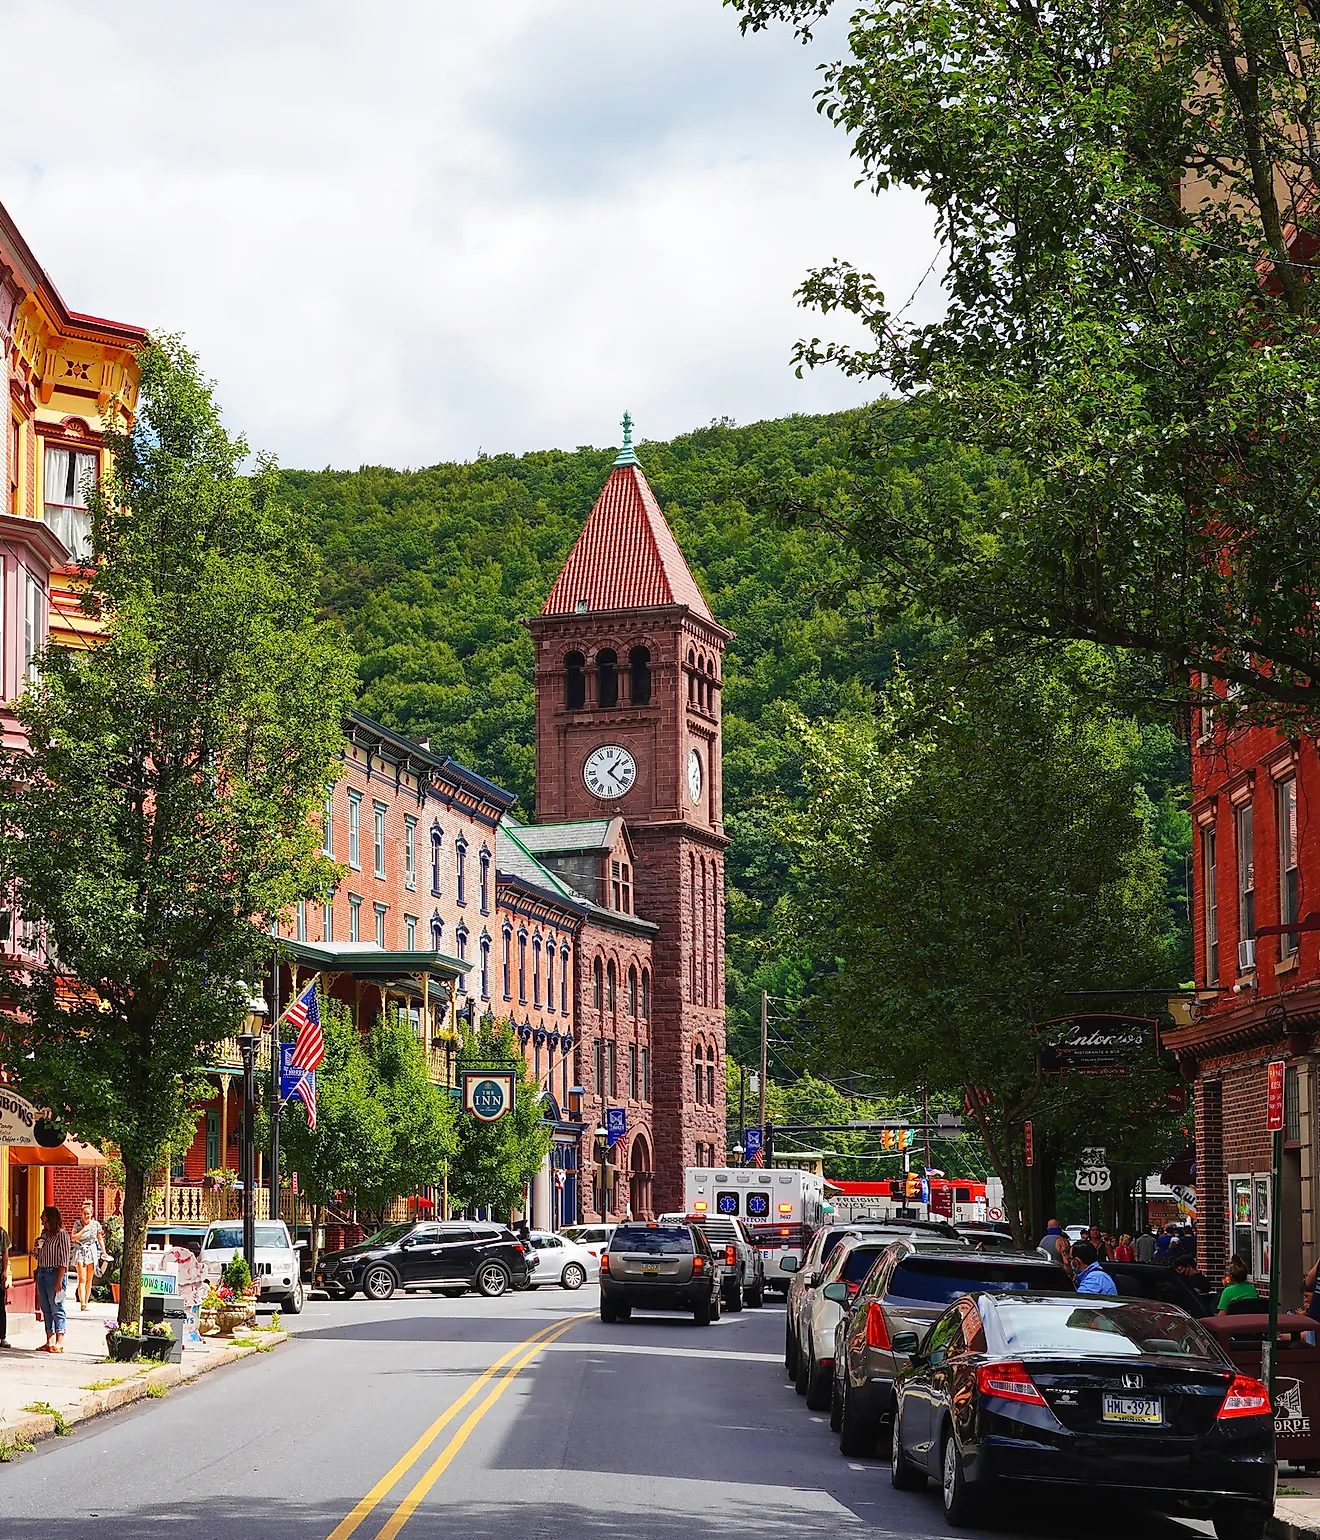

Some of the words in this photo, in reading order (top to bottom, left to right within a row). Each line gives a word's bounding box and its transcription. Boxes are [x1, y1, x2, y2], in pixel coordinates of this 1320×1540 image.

[475, 1096, 501, 1105] INN
[1078, 1171, 1108, 1187] 209
[161, 1281, 173, 1293] END
[1274, 1420, 1310, 1433] ORPE
